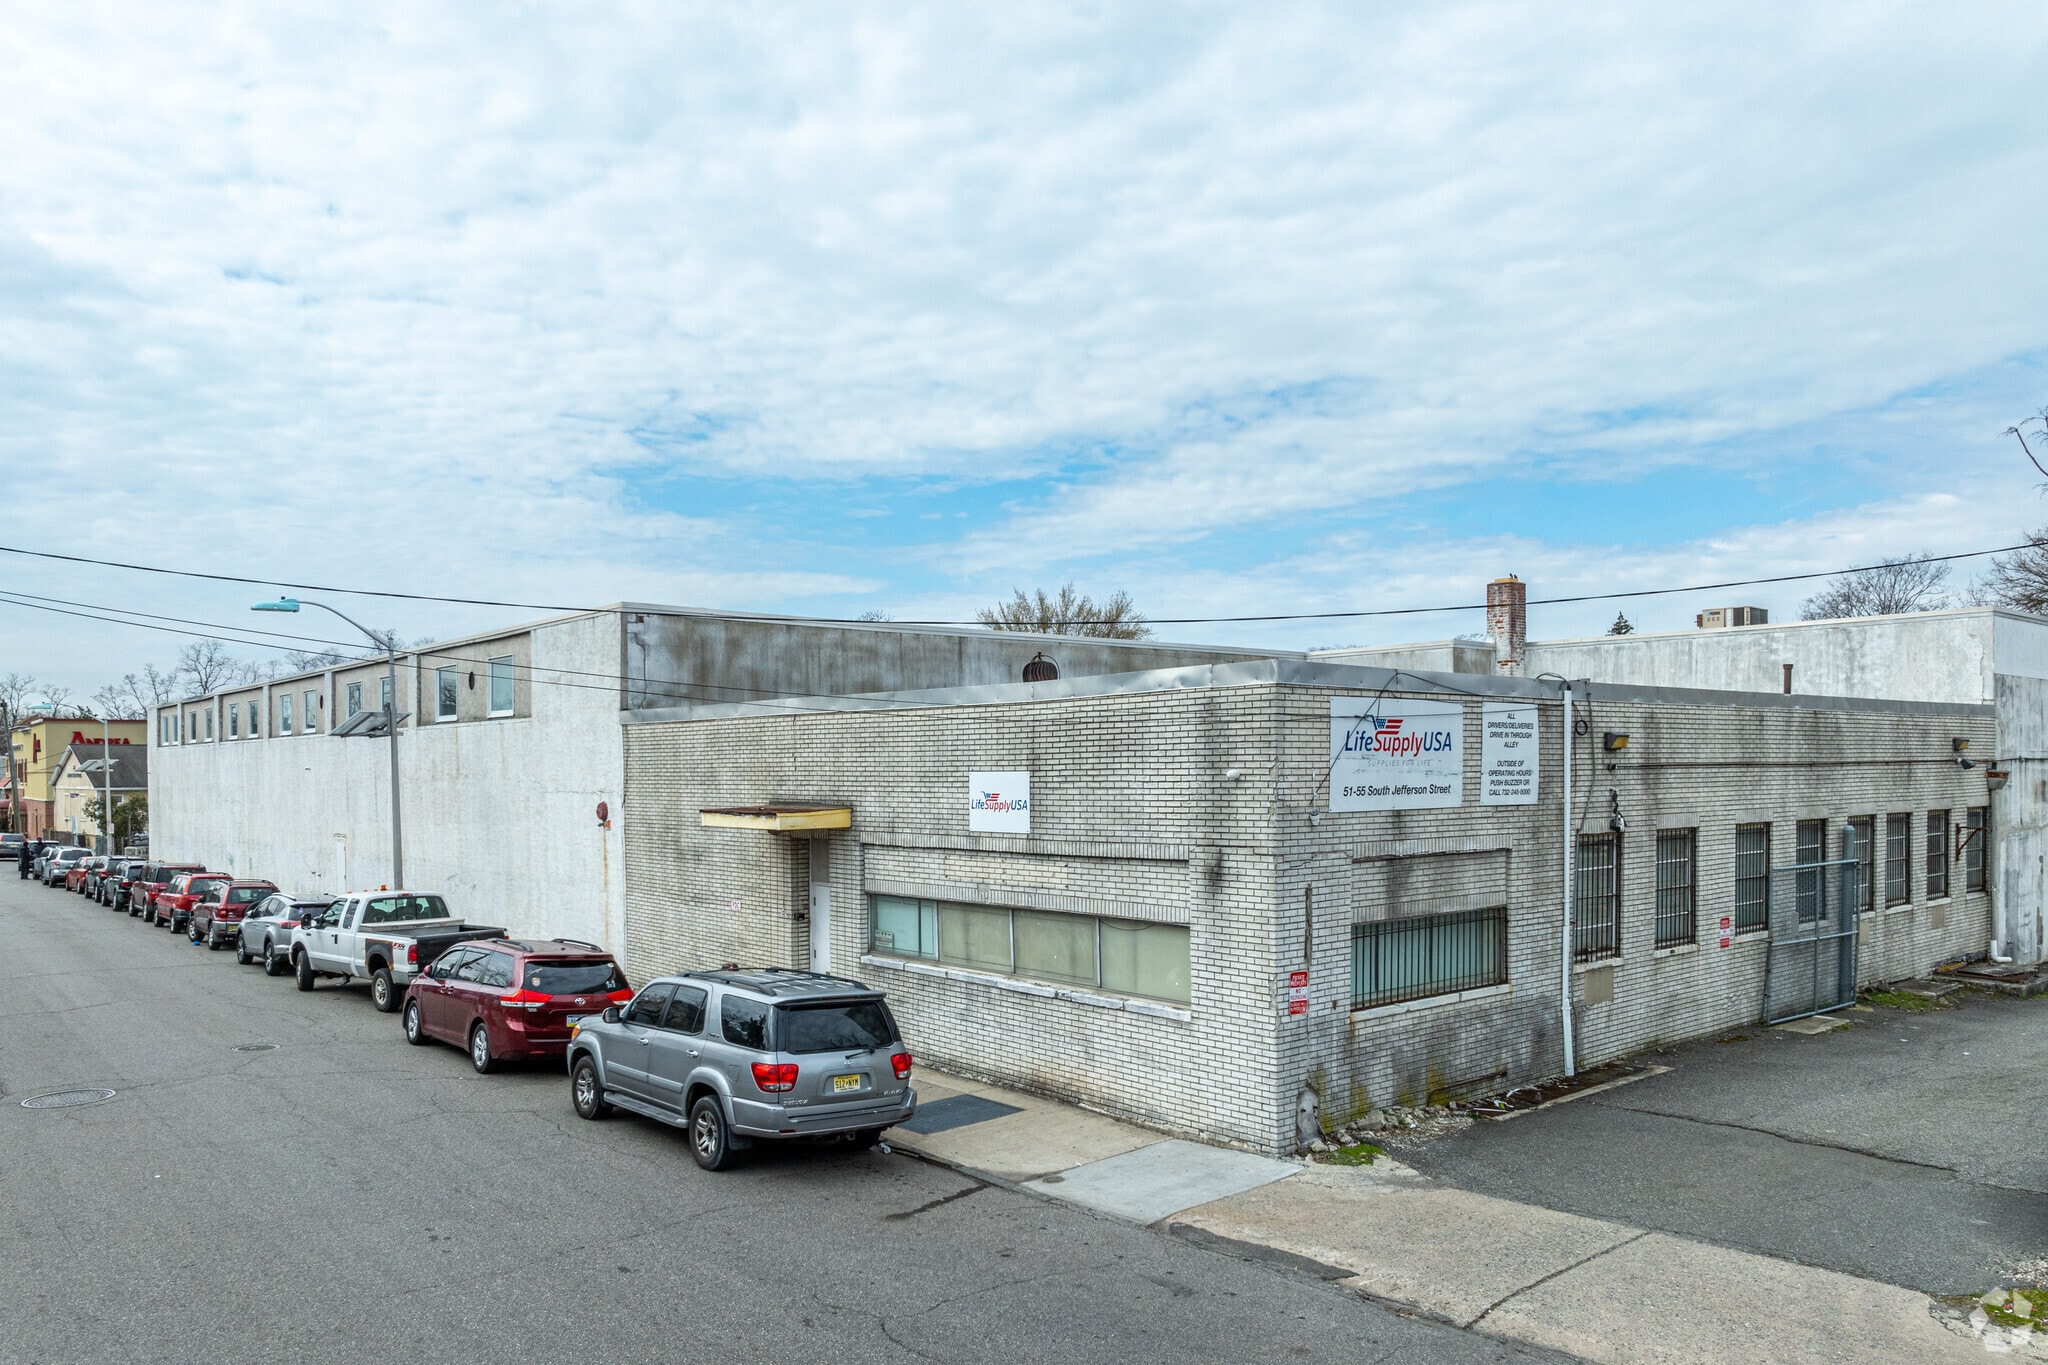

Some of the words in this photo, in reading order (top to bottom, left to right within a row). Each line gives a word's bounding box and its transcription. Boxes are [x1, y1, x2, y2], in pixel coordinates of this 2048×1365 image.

[1490, 731, 1504, 739] DRIVE
[1344, 730, 1452, 757] LifeSupplyUSA
[1488, 769, 1515, 777] OPERATING
[1515, 769, 1532, 777] HOURS
[1343, 786, 1366, 797] 51-55
[1367, 785, 1390, 796] South
[1391, 784, 1427, 795] Jefferson
[1428, 783, 1451, 794] Street
[1488, 788, 1501, 796] CALL
[971, 799, 1028, 813] LifeSupplyUSA
